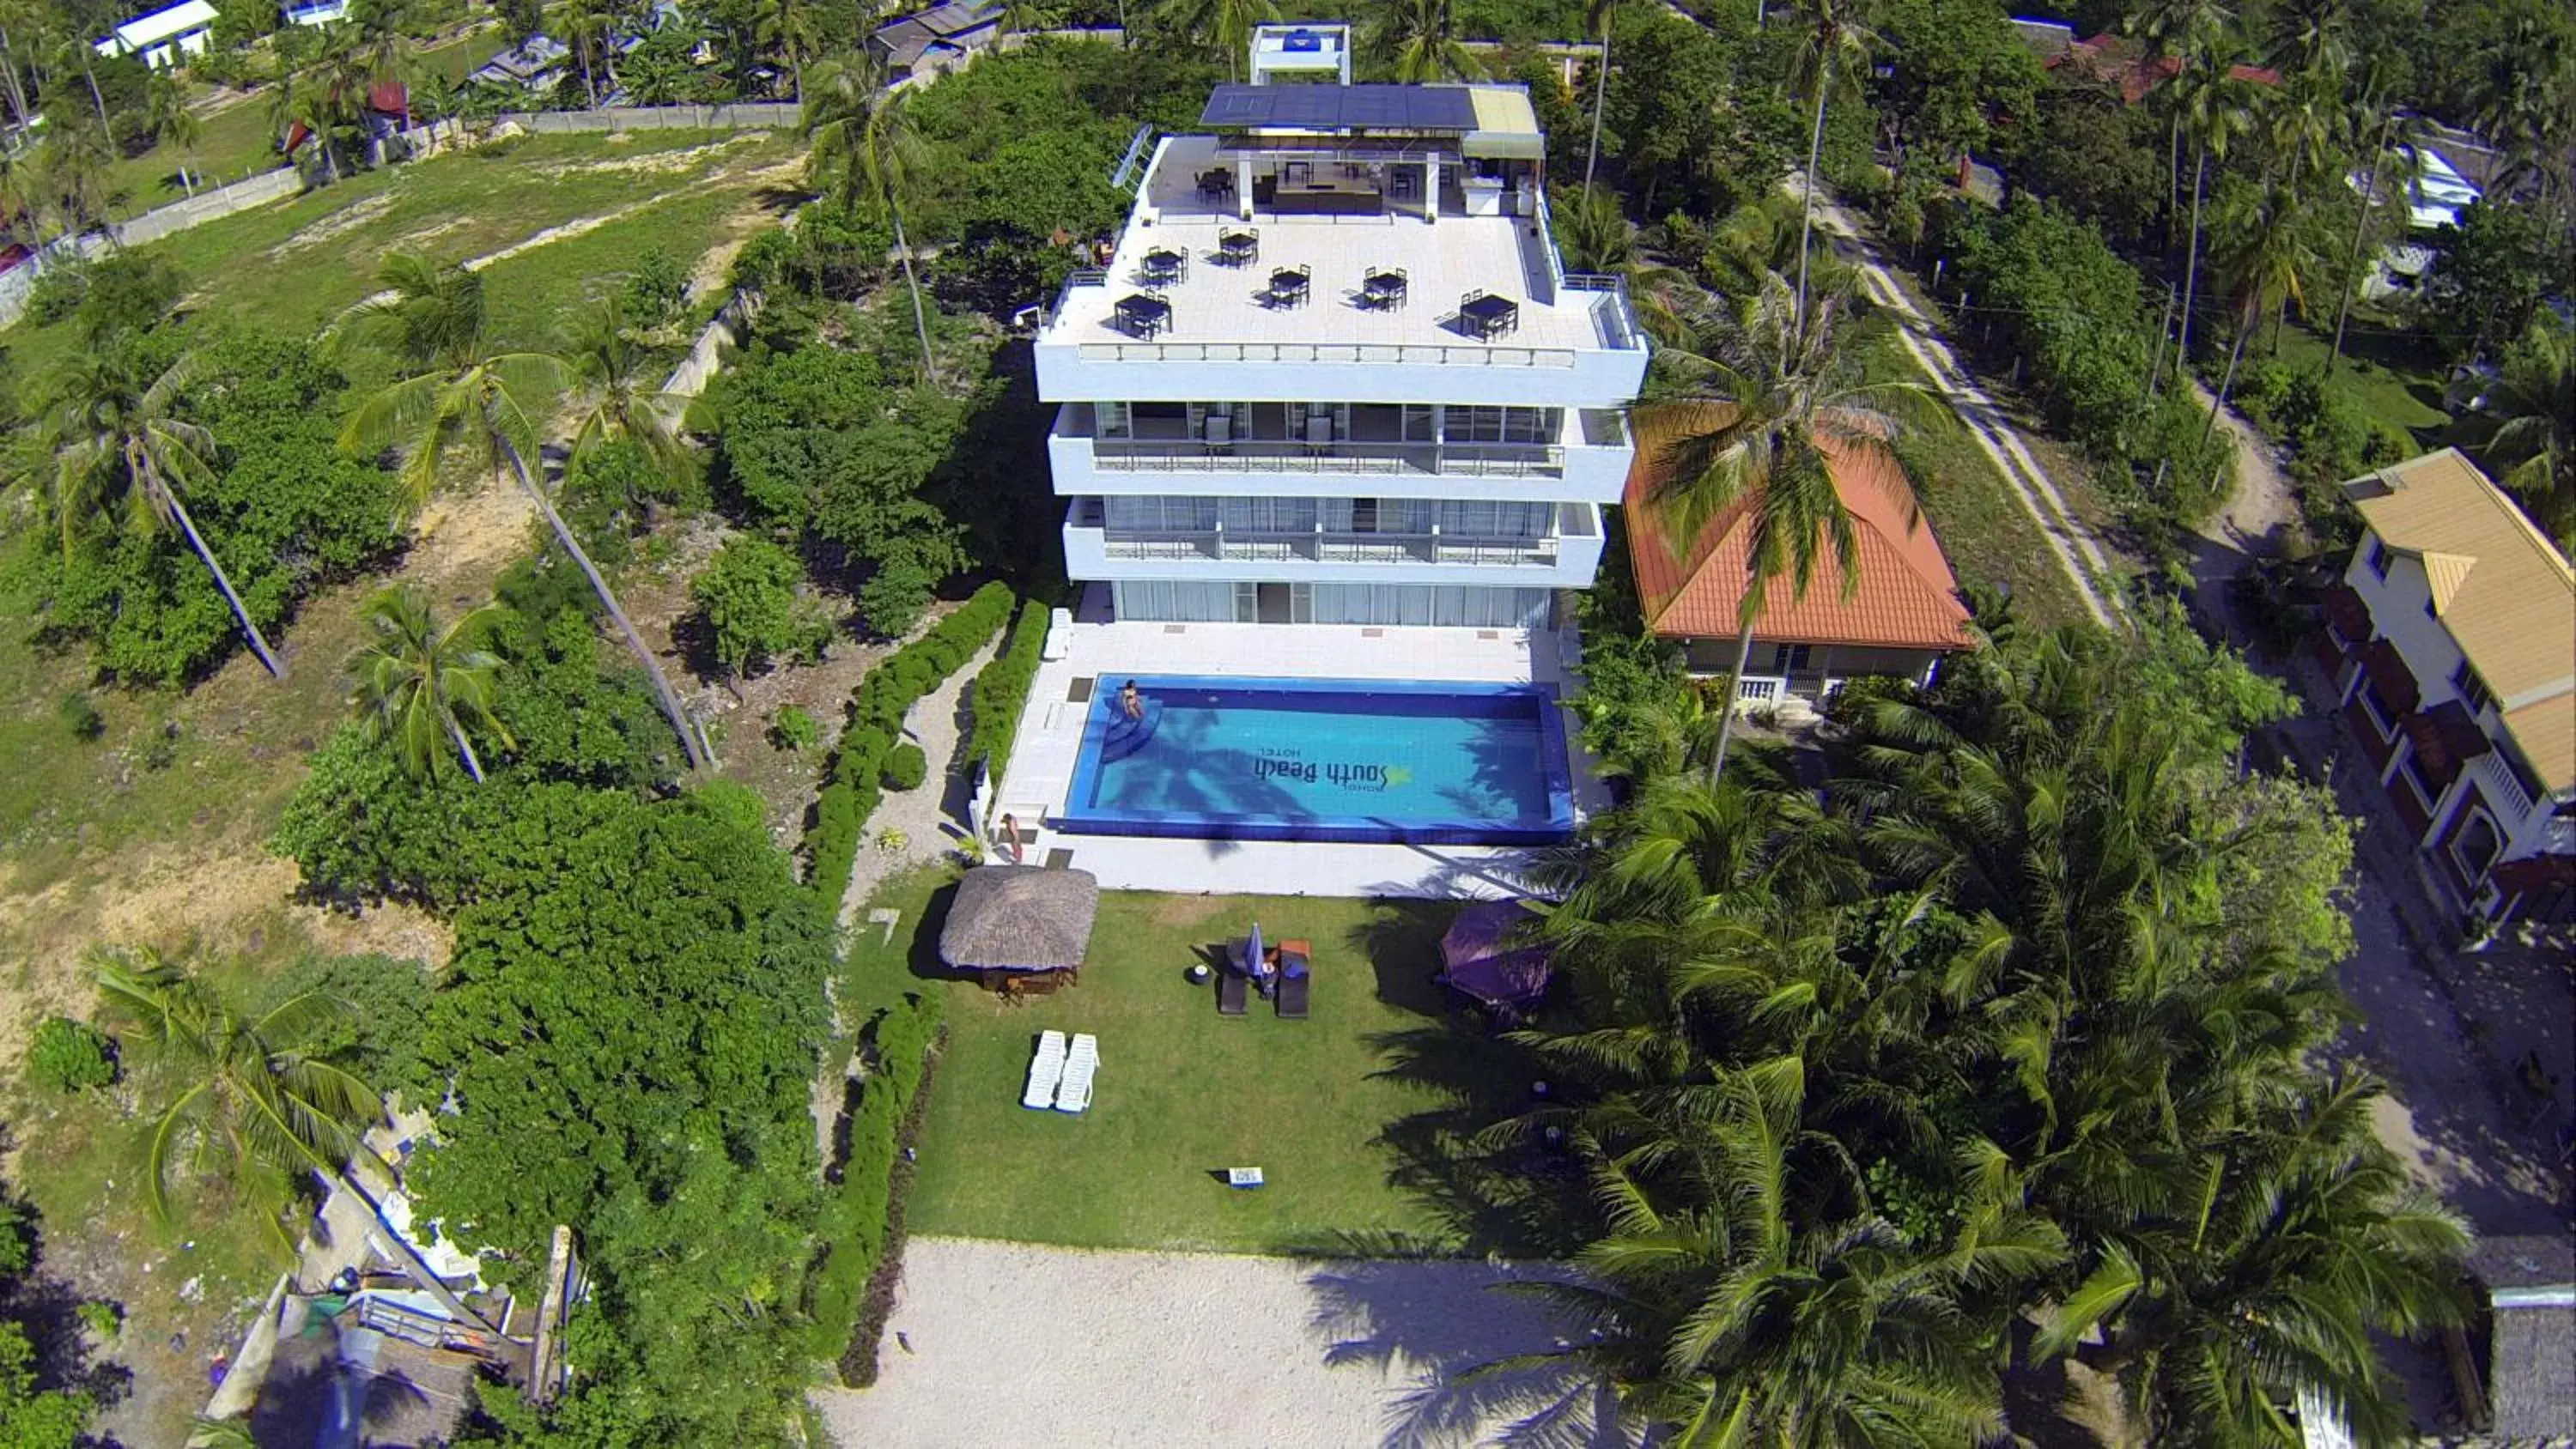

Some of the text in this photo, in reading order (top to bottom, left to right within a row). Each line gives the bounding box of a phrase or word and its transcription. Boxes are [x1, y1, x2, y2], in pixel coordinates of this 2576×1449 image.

[1258, 748, 1301, 757] HOTEL
[1255, 758, 1388, 790] South Beach
